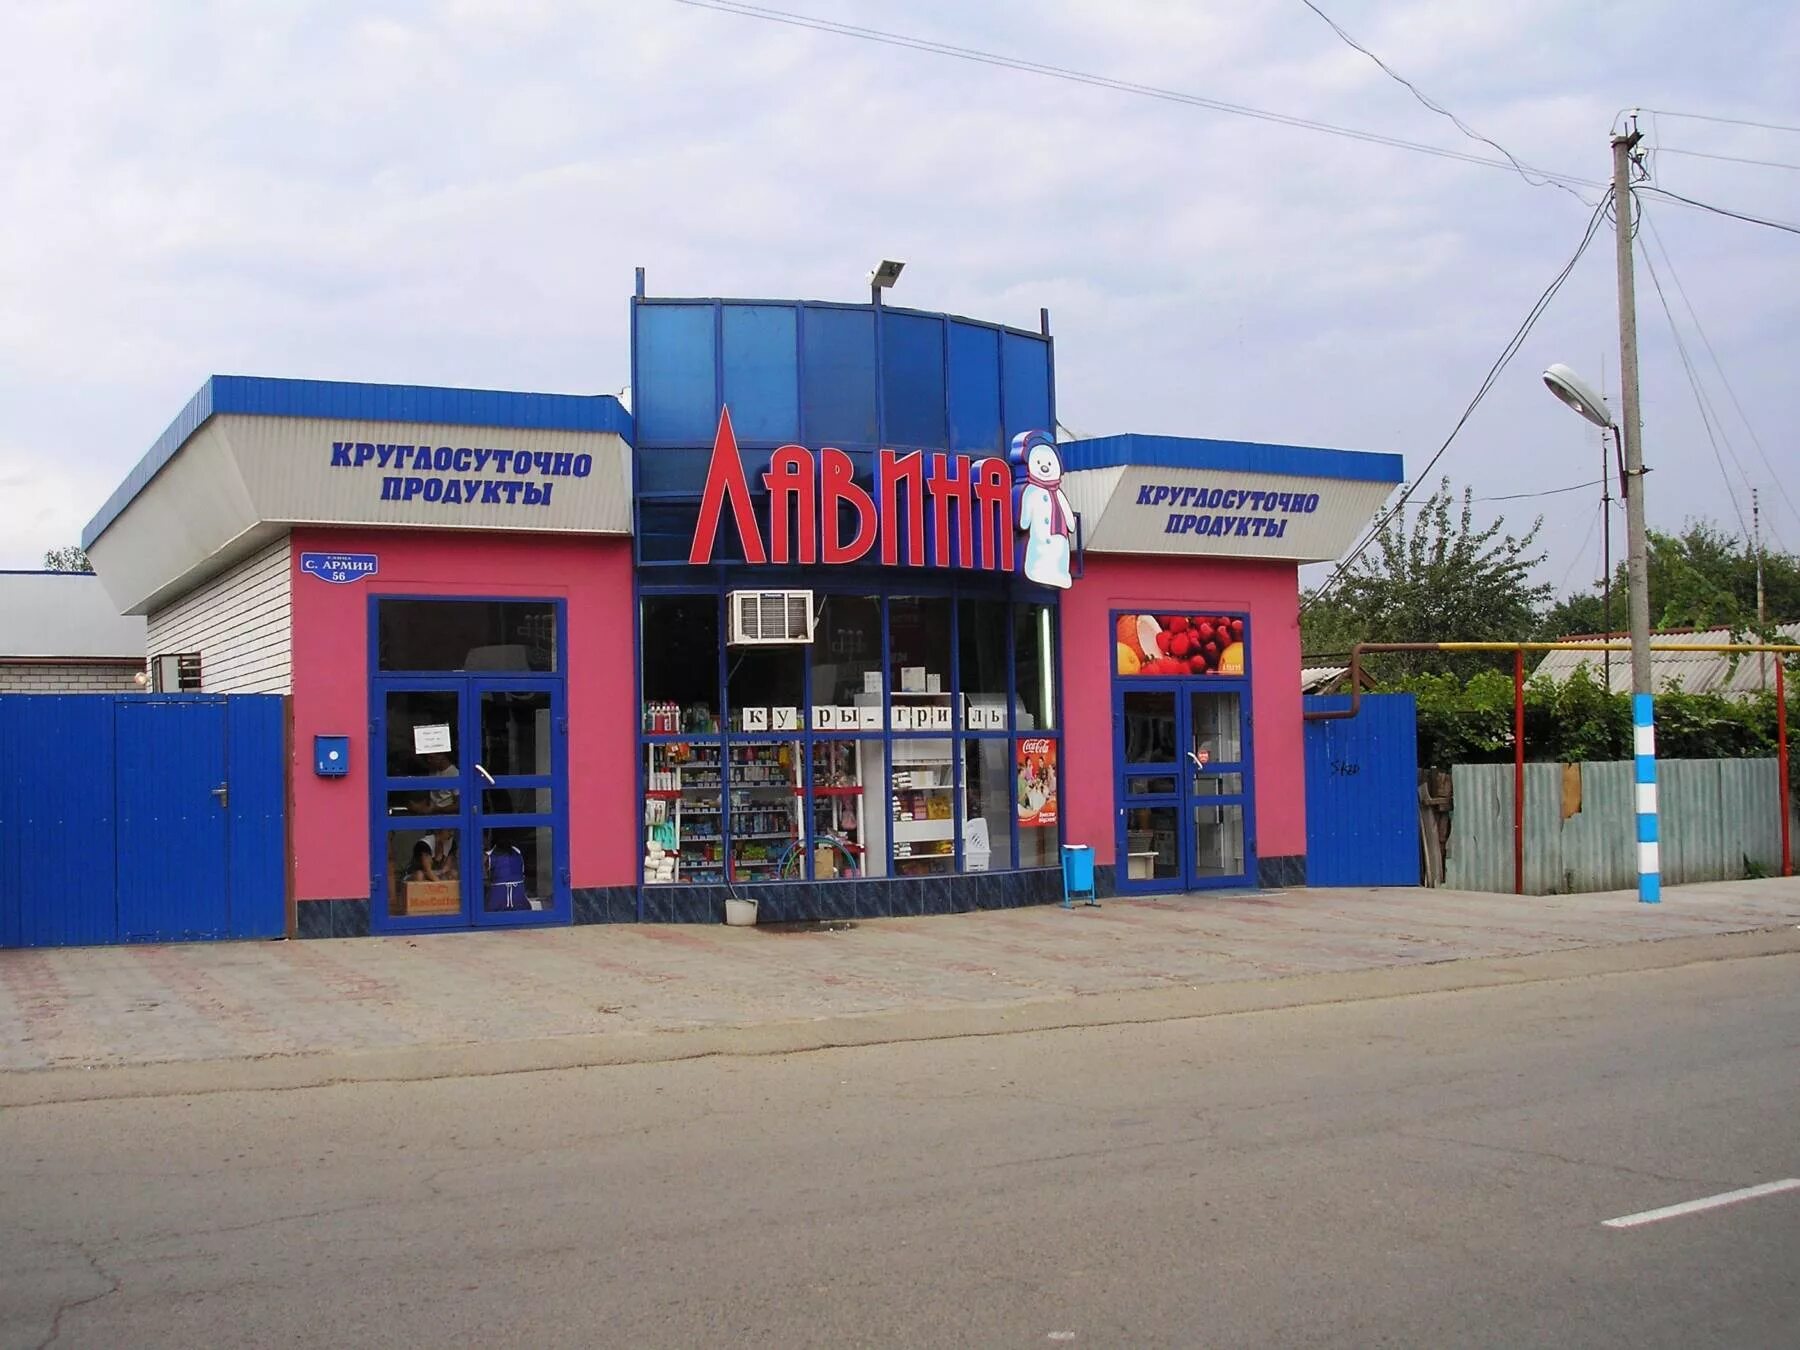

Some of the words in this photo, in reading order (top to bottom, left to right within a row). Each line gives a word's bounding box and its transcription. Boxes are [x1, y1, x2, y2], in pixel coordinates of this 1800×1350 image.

[330, 442, 593, 478] КРУГЛОСУТОЧНО
[380, 477, 553, 506] ПРОДУКТЫ
[688, 403, 1015, 572] ЛАВИНА
[1136, 485, 1320, 513] КРУГЛОСУТОЧНО
[1165, 514, 1288, 538] ПРОДУКТЫ
[305, 560, 318, 569] С.
[322, 561, 374, 571] АРМИИ
[332, 571, 346, 581] 56
